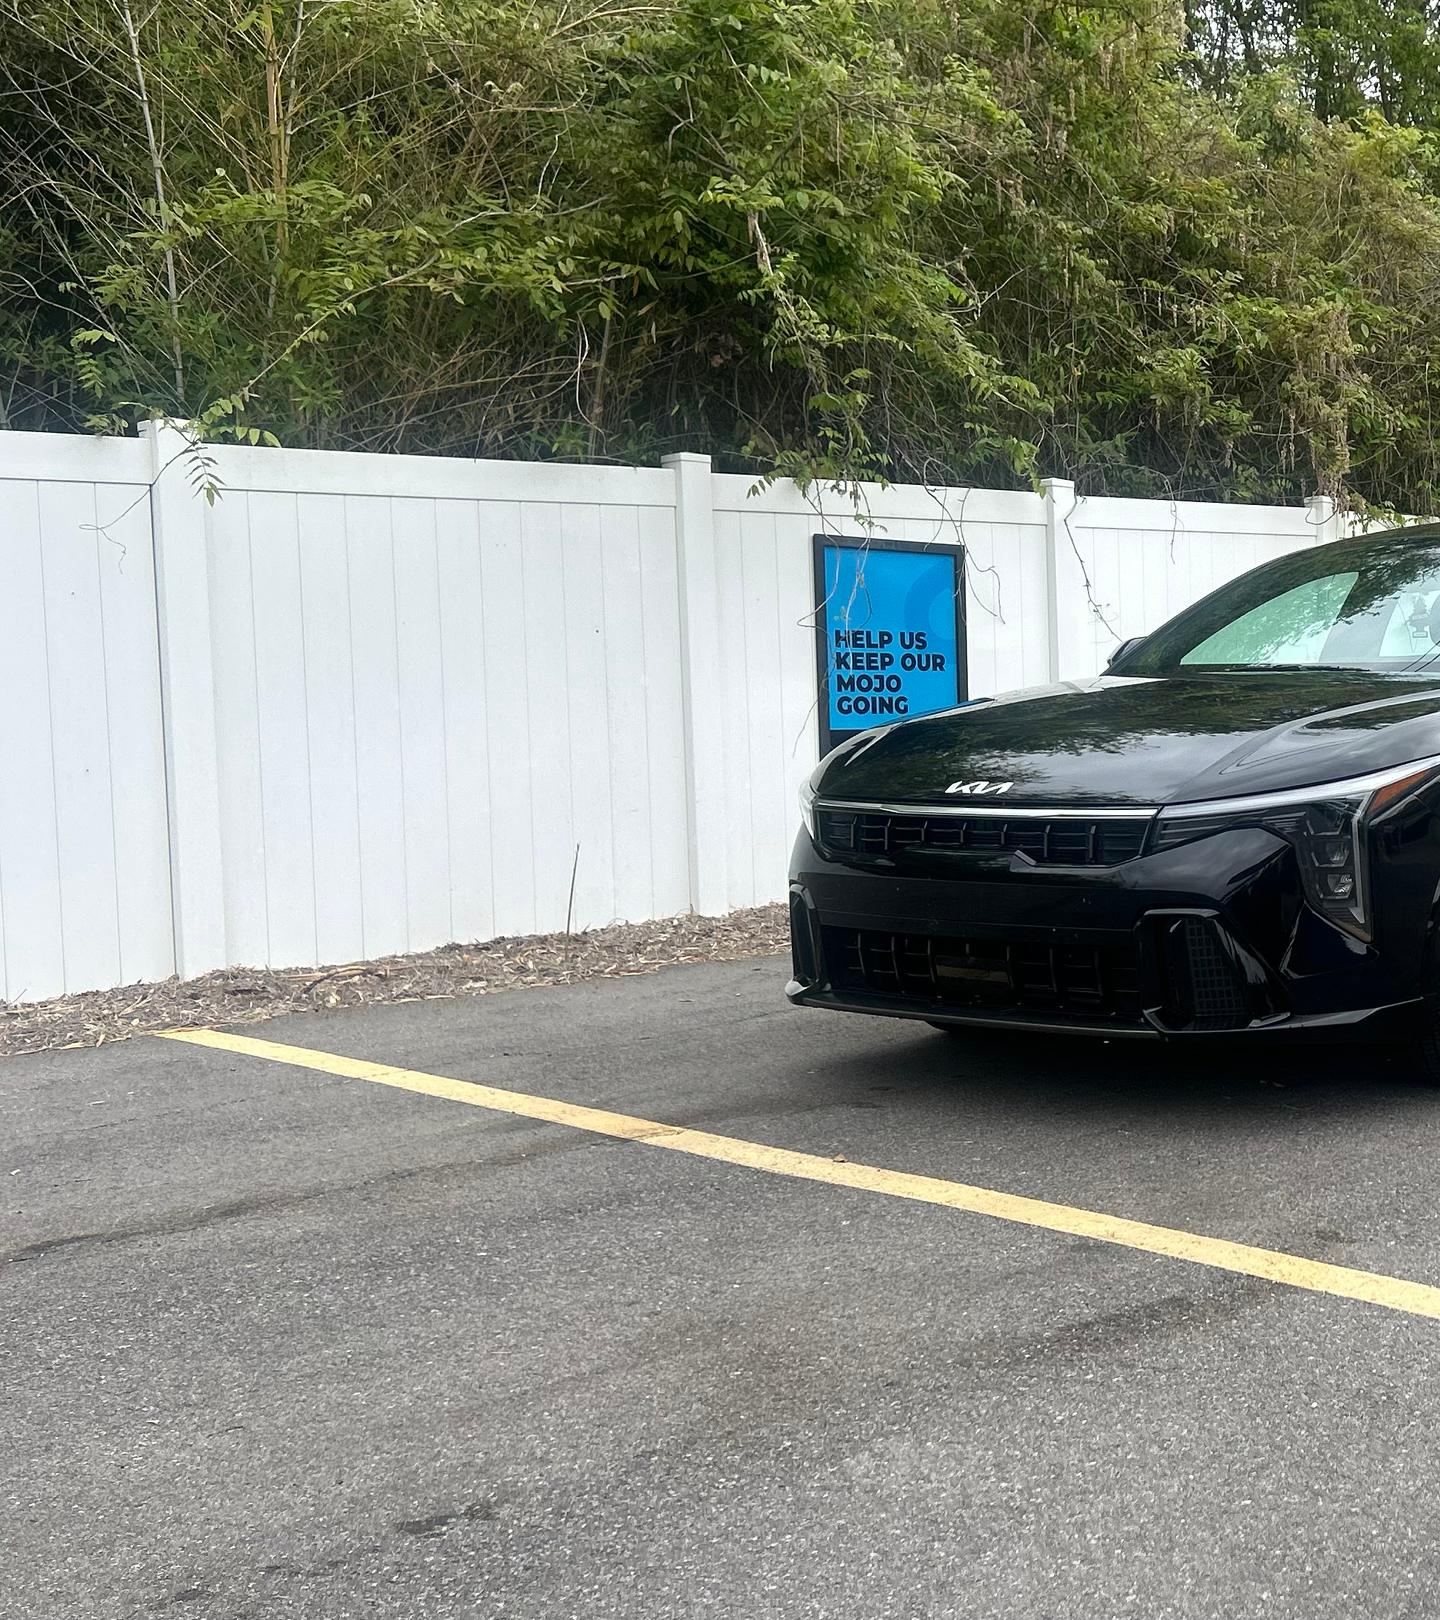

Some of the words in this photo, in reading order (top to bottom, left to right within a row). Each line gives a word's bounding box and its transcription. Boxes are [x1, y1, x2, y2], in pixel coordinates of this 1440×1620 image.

[834, 630, 893, 649] HELP
[900, 631, 927, 650] US
[835, 652, 894, 671] KEEP
[901, 653, 945, 671] OUR
[837, 675, 901, 692] MOJO
[837, 696, 909, 715] GOING
[945, 781, 1014, 794] KIA
